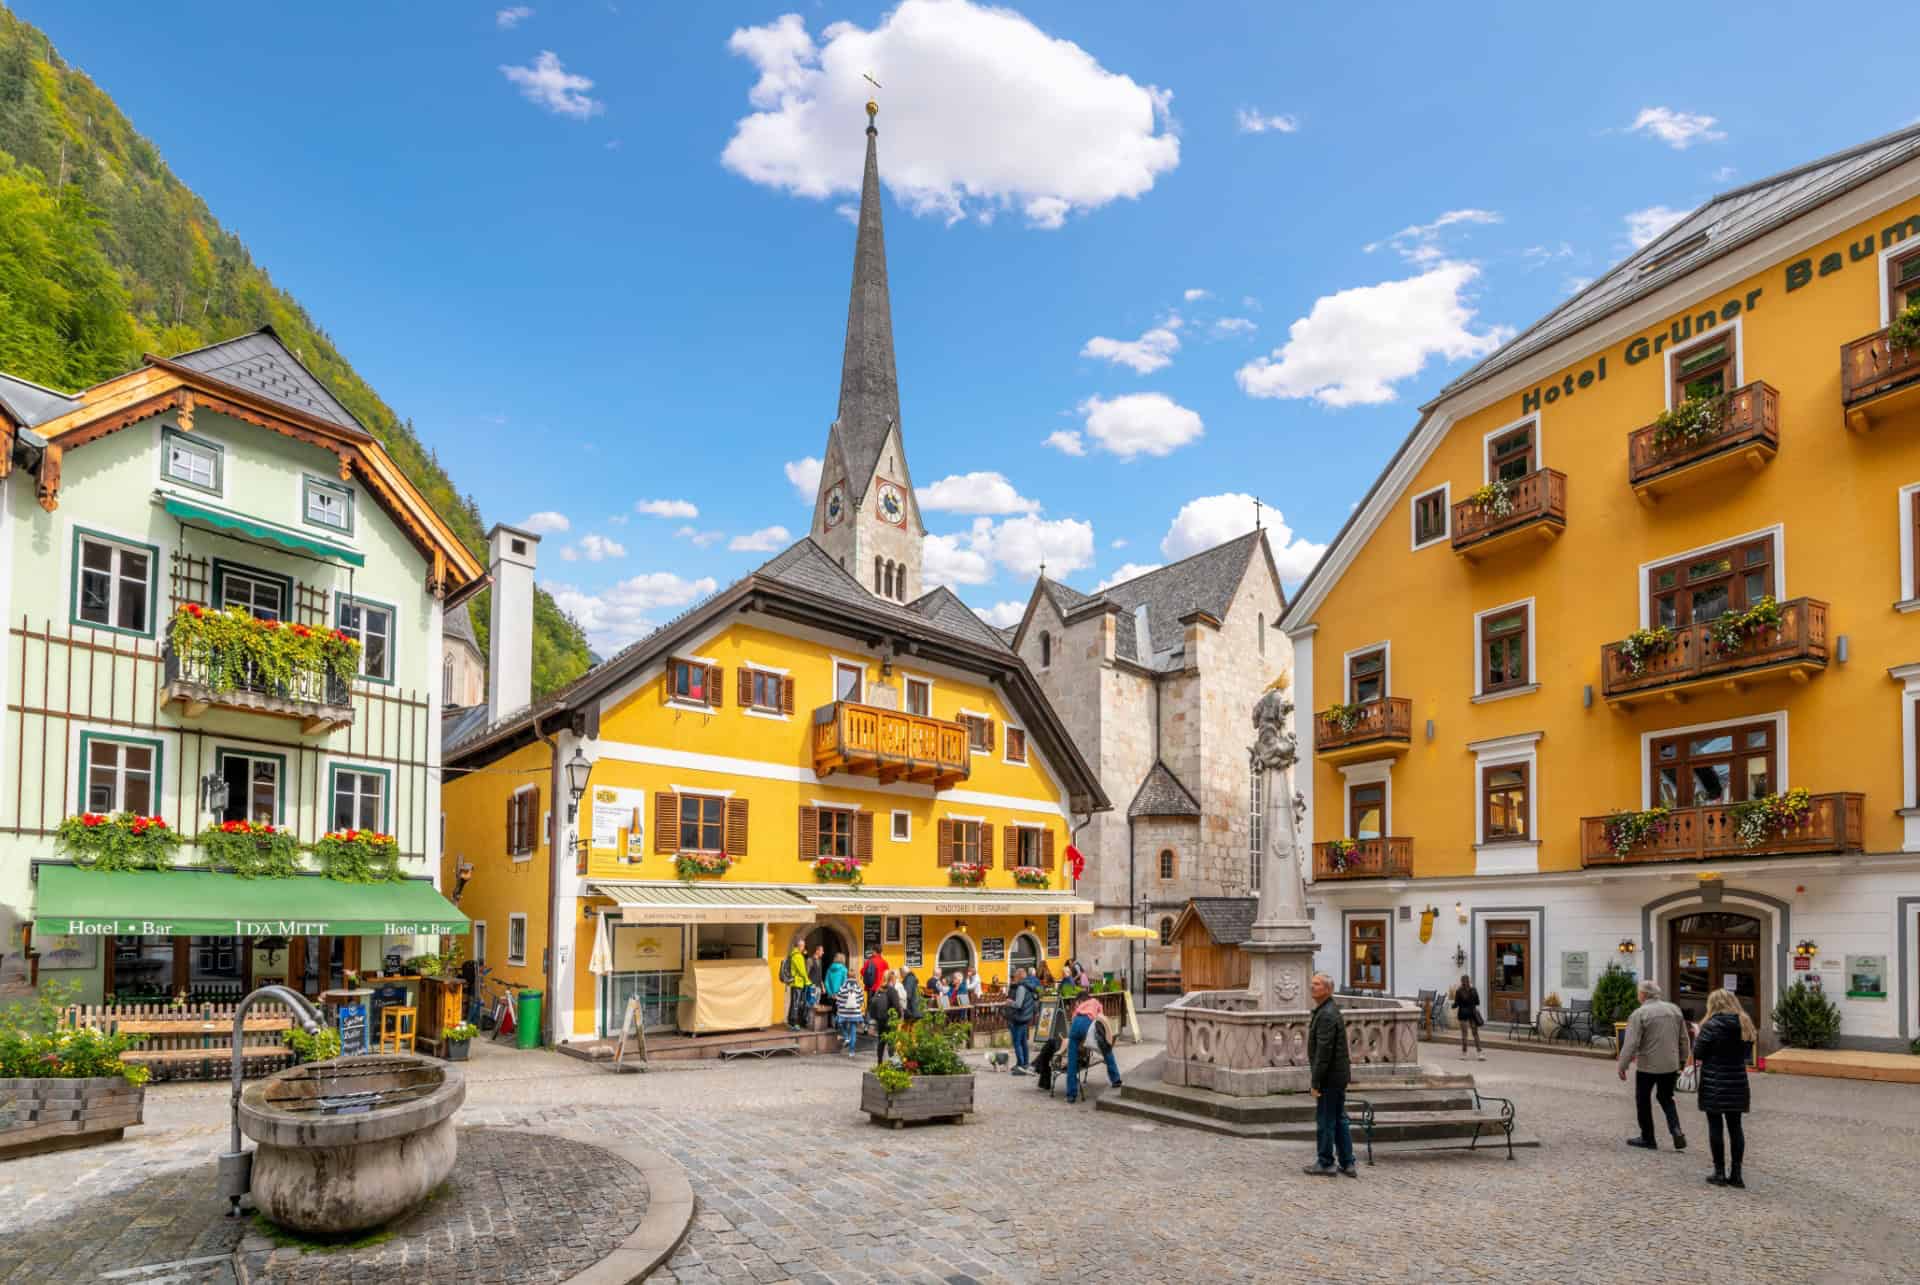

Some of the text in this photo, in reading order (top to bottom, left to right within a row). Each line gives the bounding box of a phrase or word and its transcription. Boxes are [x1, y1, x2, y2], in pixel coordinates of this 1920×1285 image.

[1522, 214, 1920, 414] Hotel Grüner Baum
[68, 920, 173, 935] Hotel Bar
[384, 922, 452, 936] Hotel Bar
